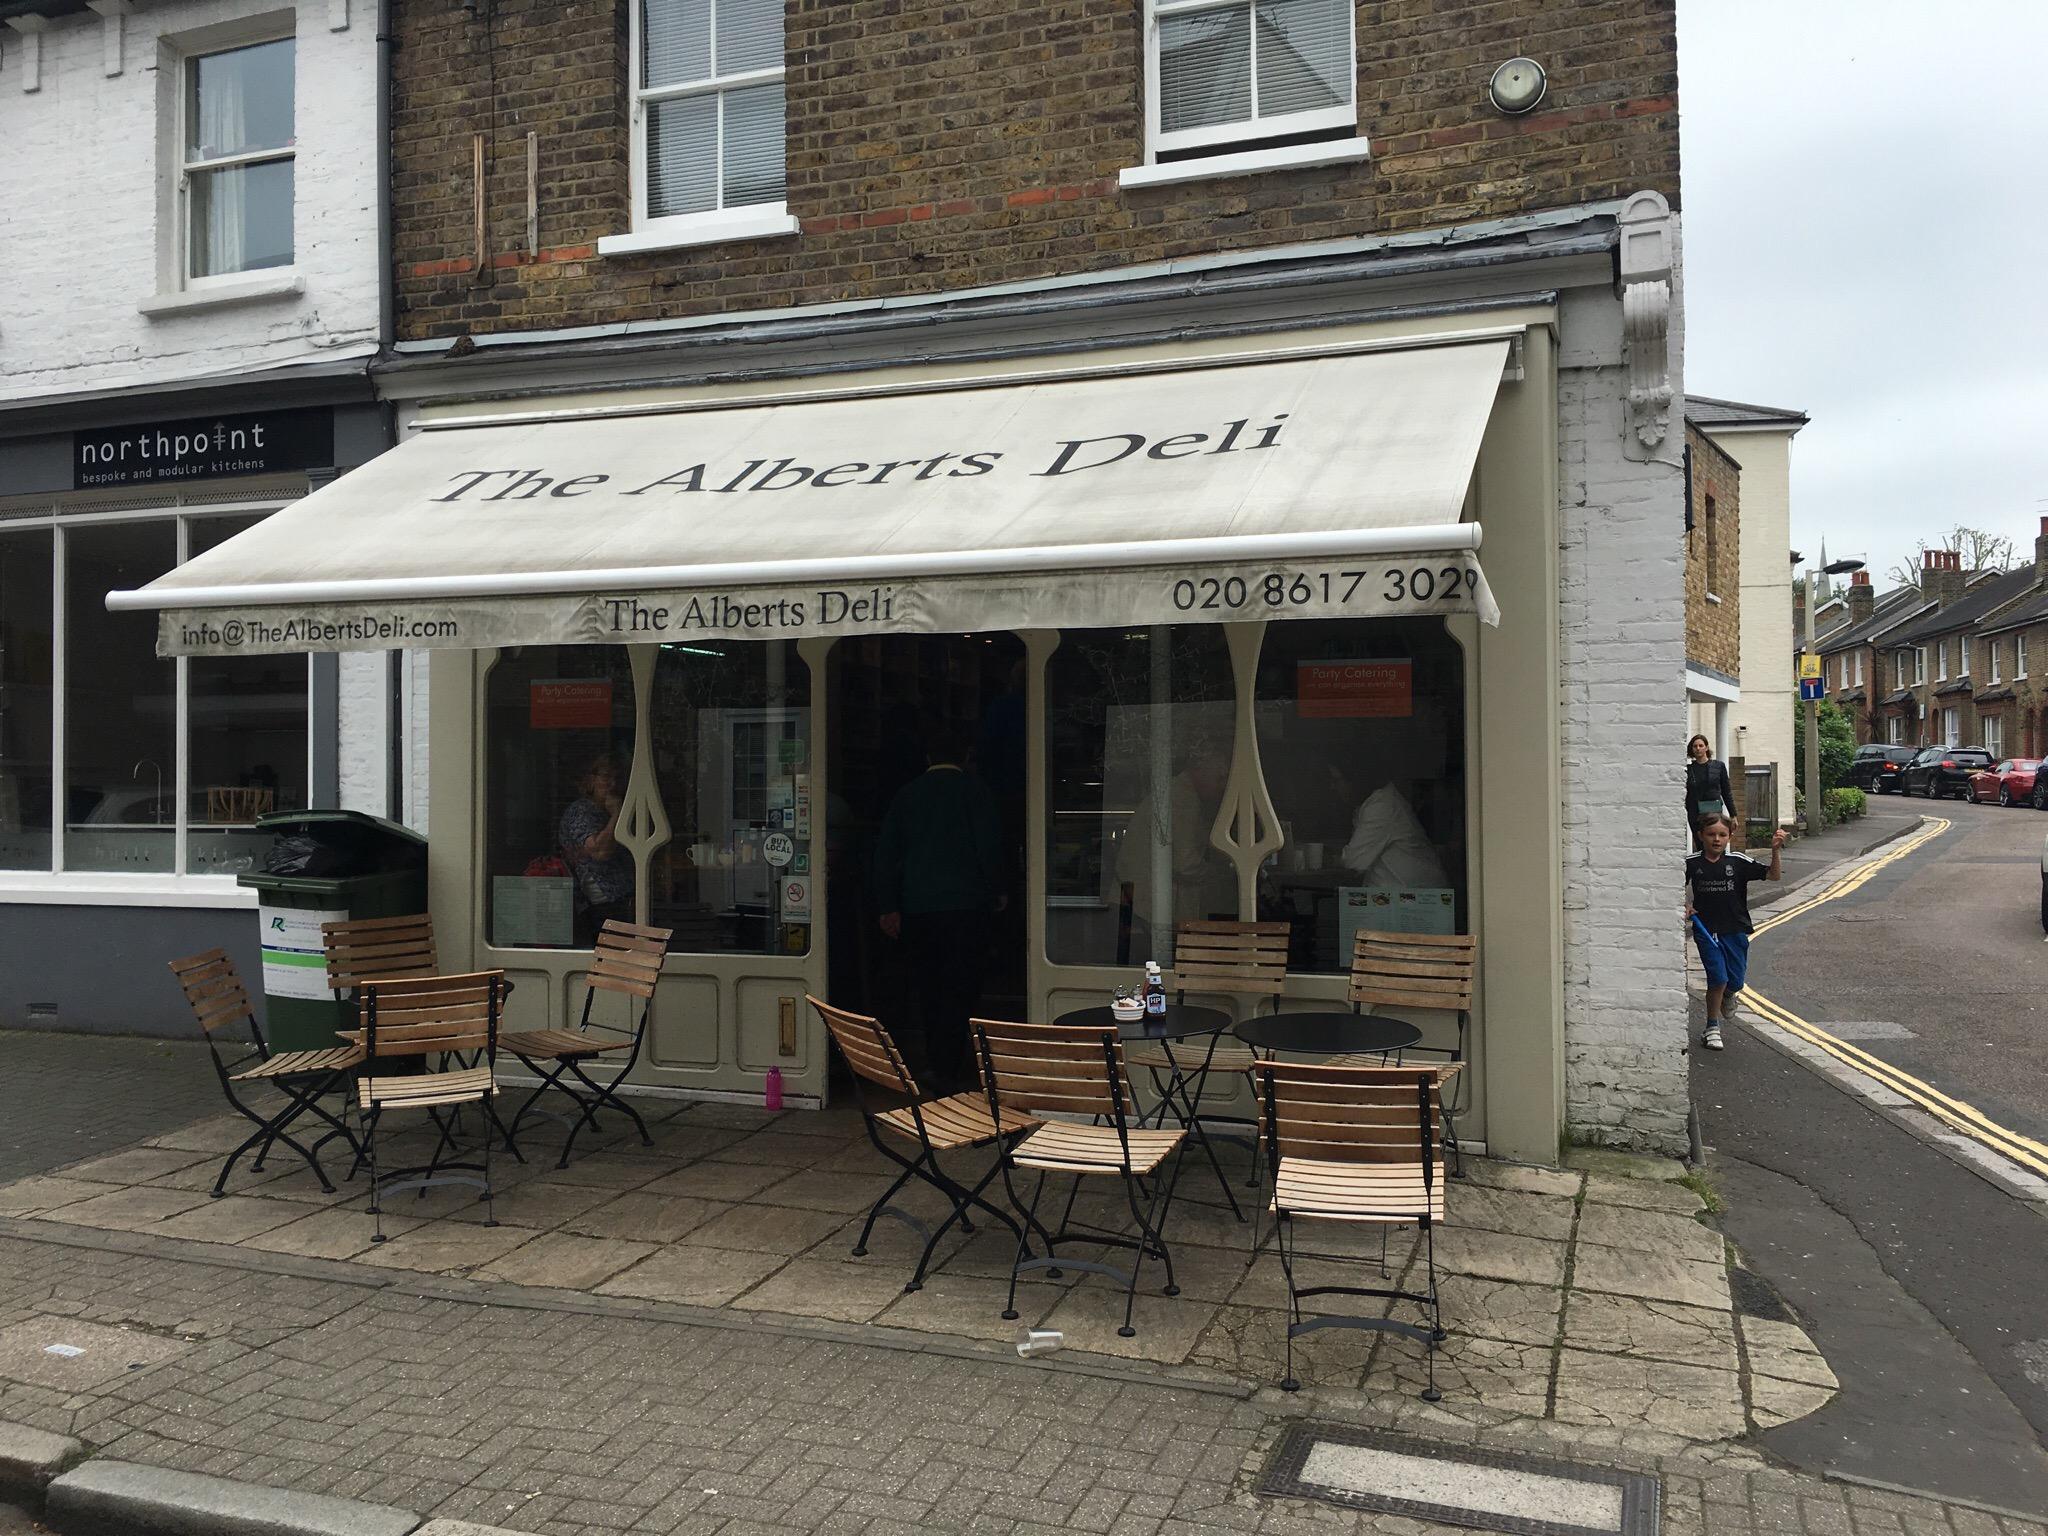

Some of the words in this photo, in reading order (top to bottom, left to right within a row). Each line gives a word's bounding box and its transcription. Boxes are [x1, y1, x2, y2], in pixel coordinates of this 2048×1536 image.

[82, 471, 126, 483] bespoke
[133, 468, 151, 479] and
[158, 464, 203, 476] modular
[211, 459, 264, 472] kitchens
[429, 468, 610, 502] The
[619, 450, 1004, 496] Alberts
[1029, 413, 1289, 477] Deli
[1172, 576, 1247, 611] 020
[1263, 571, 1367, 606] 8617
[604, 596, 669, 632] The
[679, 594, 805, 630] Alberts
[817, 586, 892, 625] Deli
[182, 615, 458, 646] info@TheAlbertsDeli.com
[1312, 667, 1340, 680] Party
[1344, 666, 1396, 679] Catering
[766, 843, 791, 854] LOCAL
[771, 837, 788, 846] BUY
